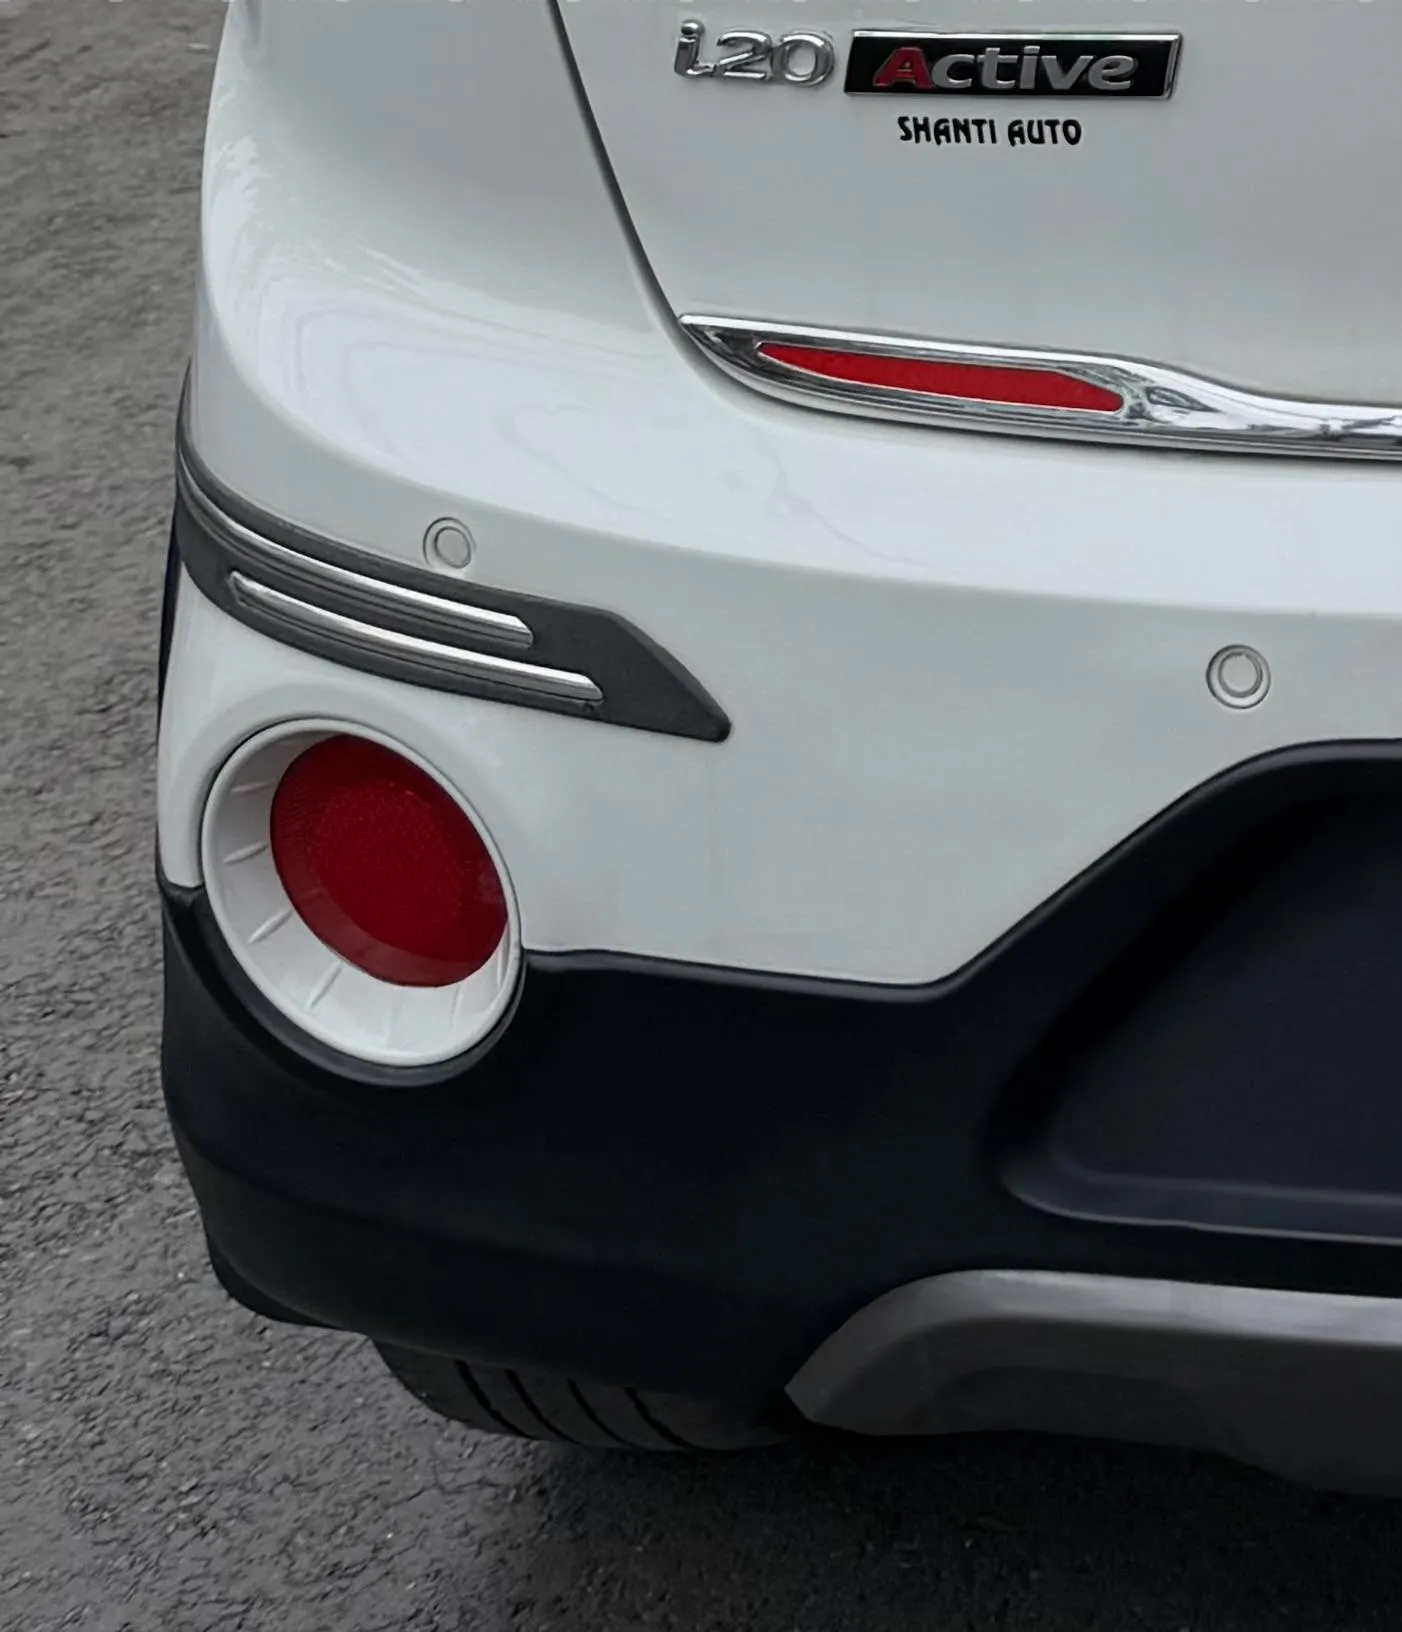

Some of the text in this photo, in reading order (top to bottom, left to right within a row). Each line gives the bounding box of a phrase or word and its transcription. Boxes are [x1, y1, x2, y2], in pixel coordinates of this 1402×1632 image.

[674, 19, 1139, 90] i20 Active
[898, 115, 1082, 146] SHANTI AUTO
